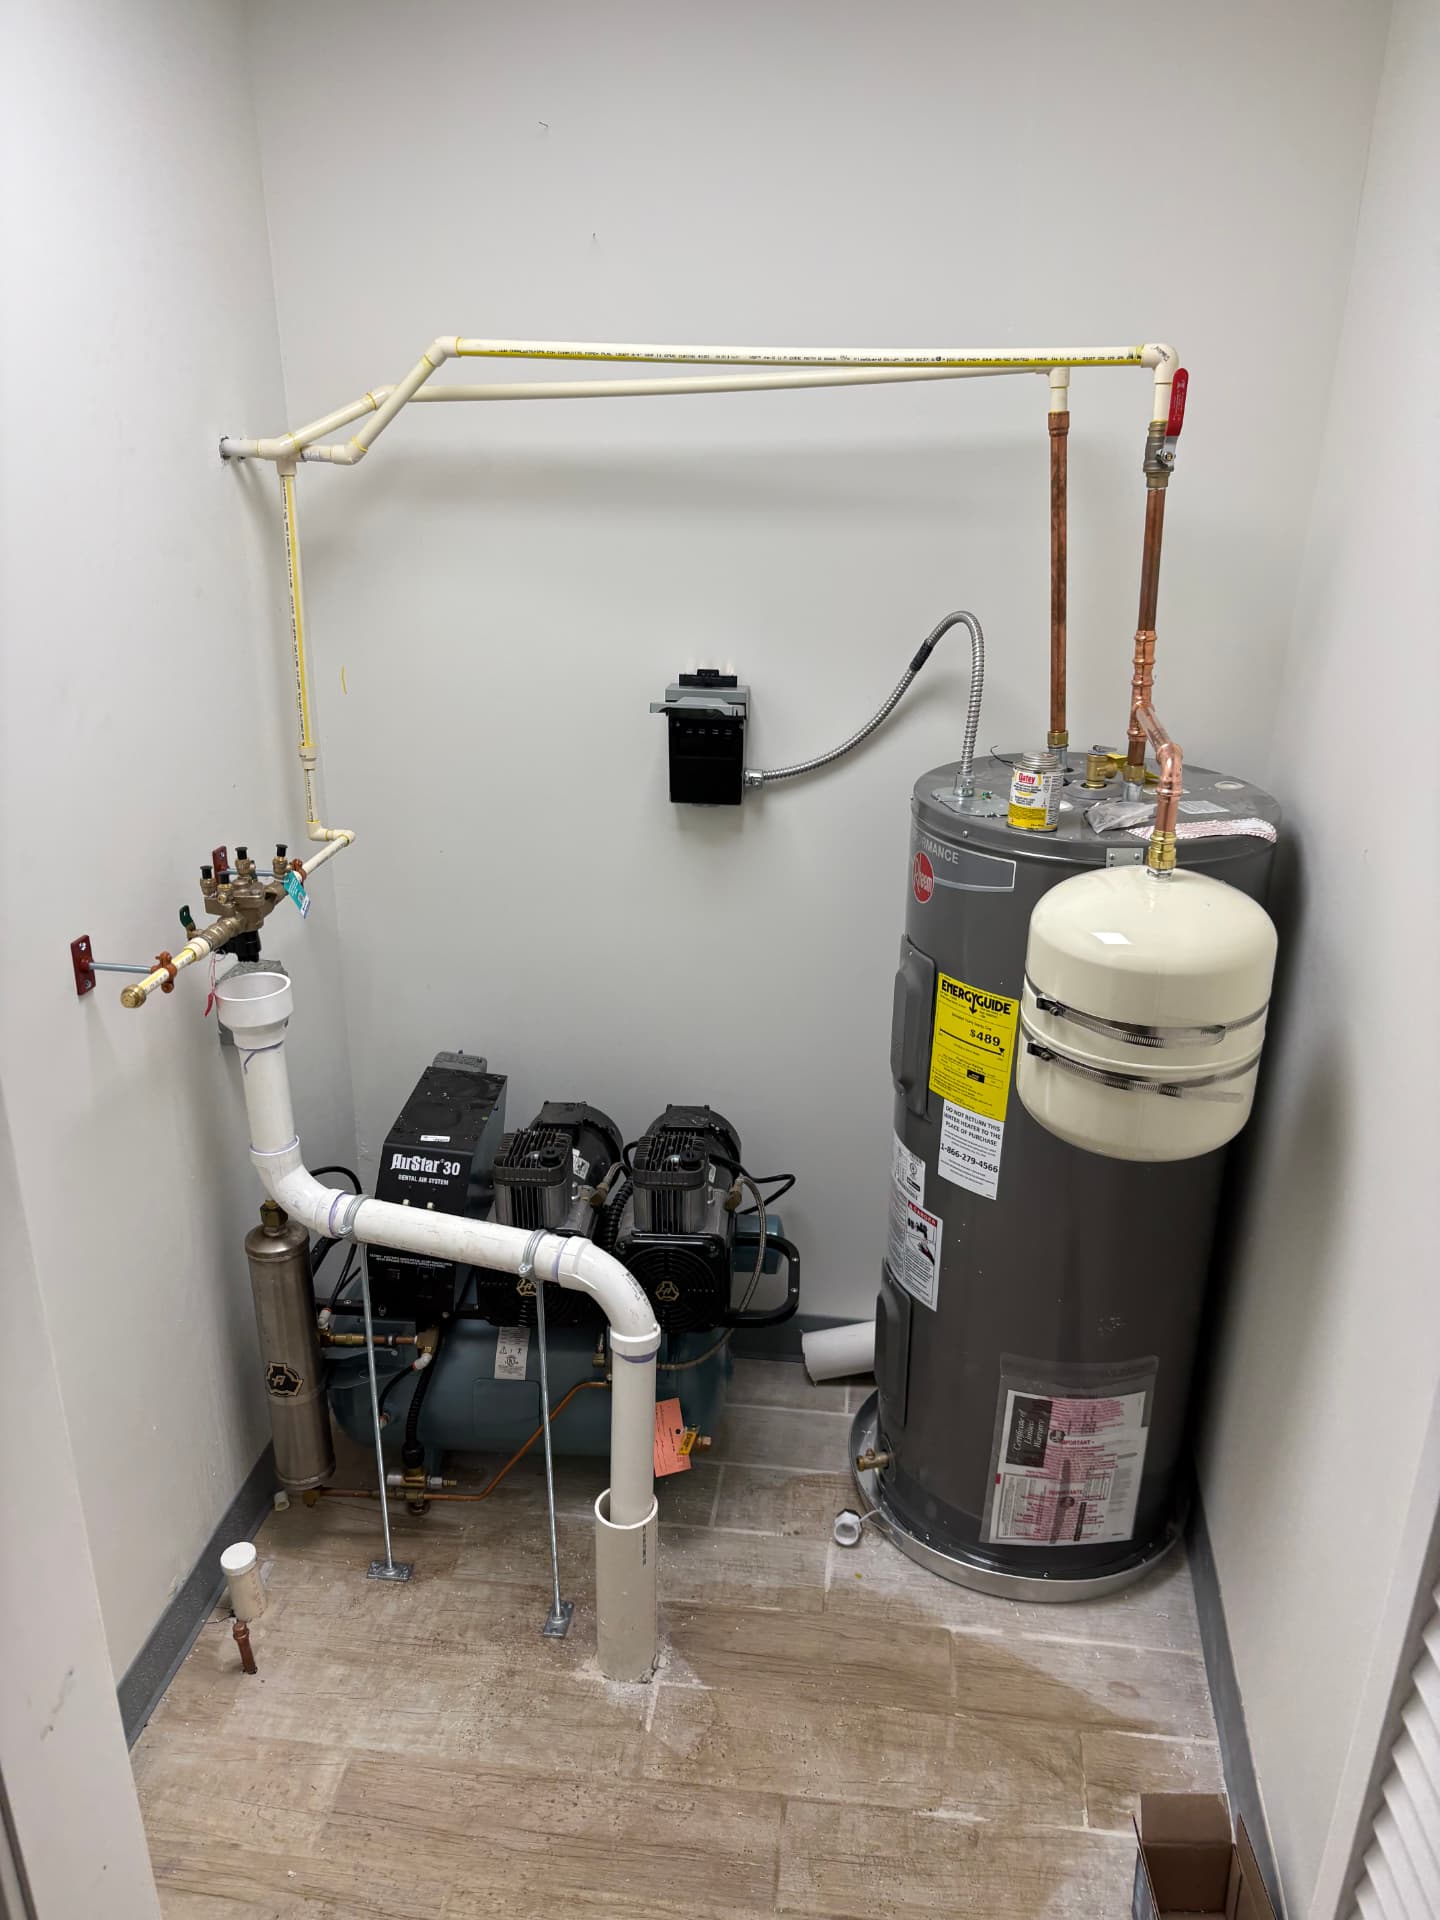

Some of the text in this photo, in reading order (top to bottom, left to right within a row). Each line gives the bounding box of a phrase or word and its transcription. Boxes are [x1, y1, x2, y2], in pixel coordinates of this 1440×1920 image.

[1018, 772, 1035, 784] Oatey
[921, 838, 959, 864] RMANCE
[942, 980, 1011, 1015] ENERGYGUIDE
[970, 1029, 1000, 1046] $489
[944, 1112, 1001, 1140] WATER HEATER TO THE
[946, 1105, 1001, 1132] DO NOT RETURN THIS
[945, 1121, 998, 1147] PLACE OF PURCHASE
[390, 1154, 461, 1176] AirStar 30
[940, 1143, 998, 1174] 1-866-279-4566
[398, 1174, 449, 1186] DENTAL AIR SYSTEM
